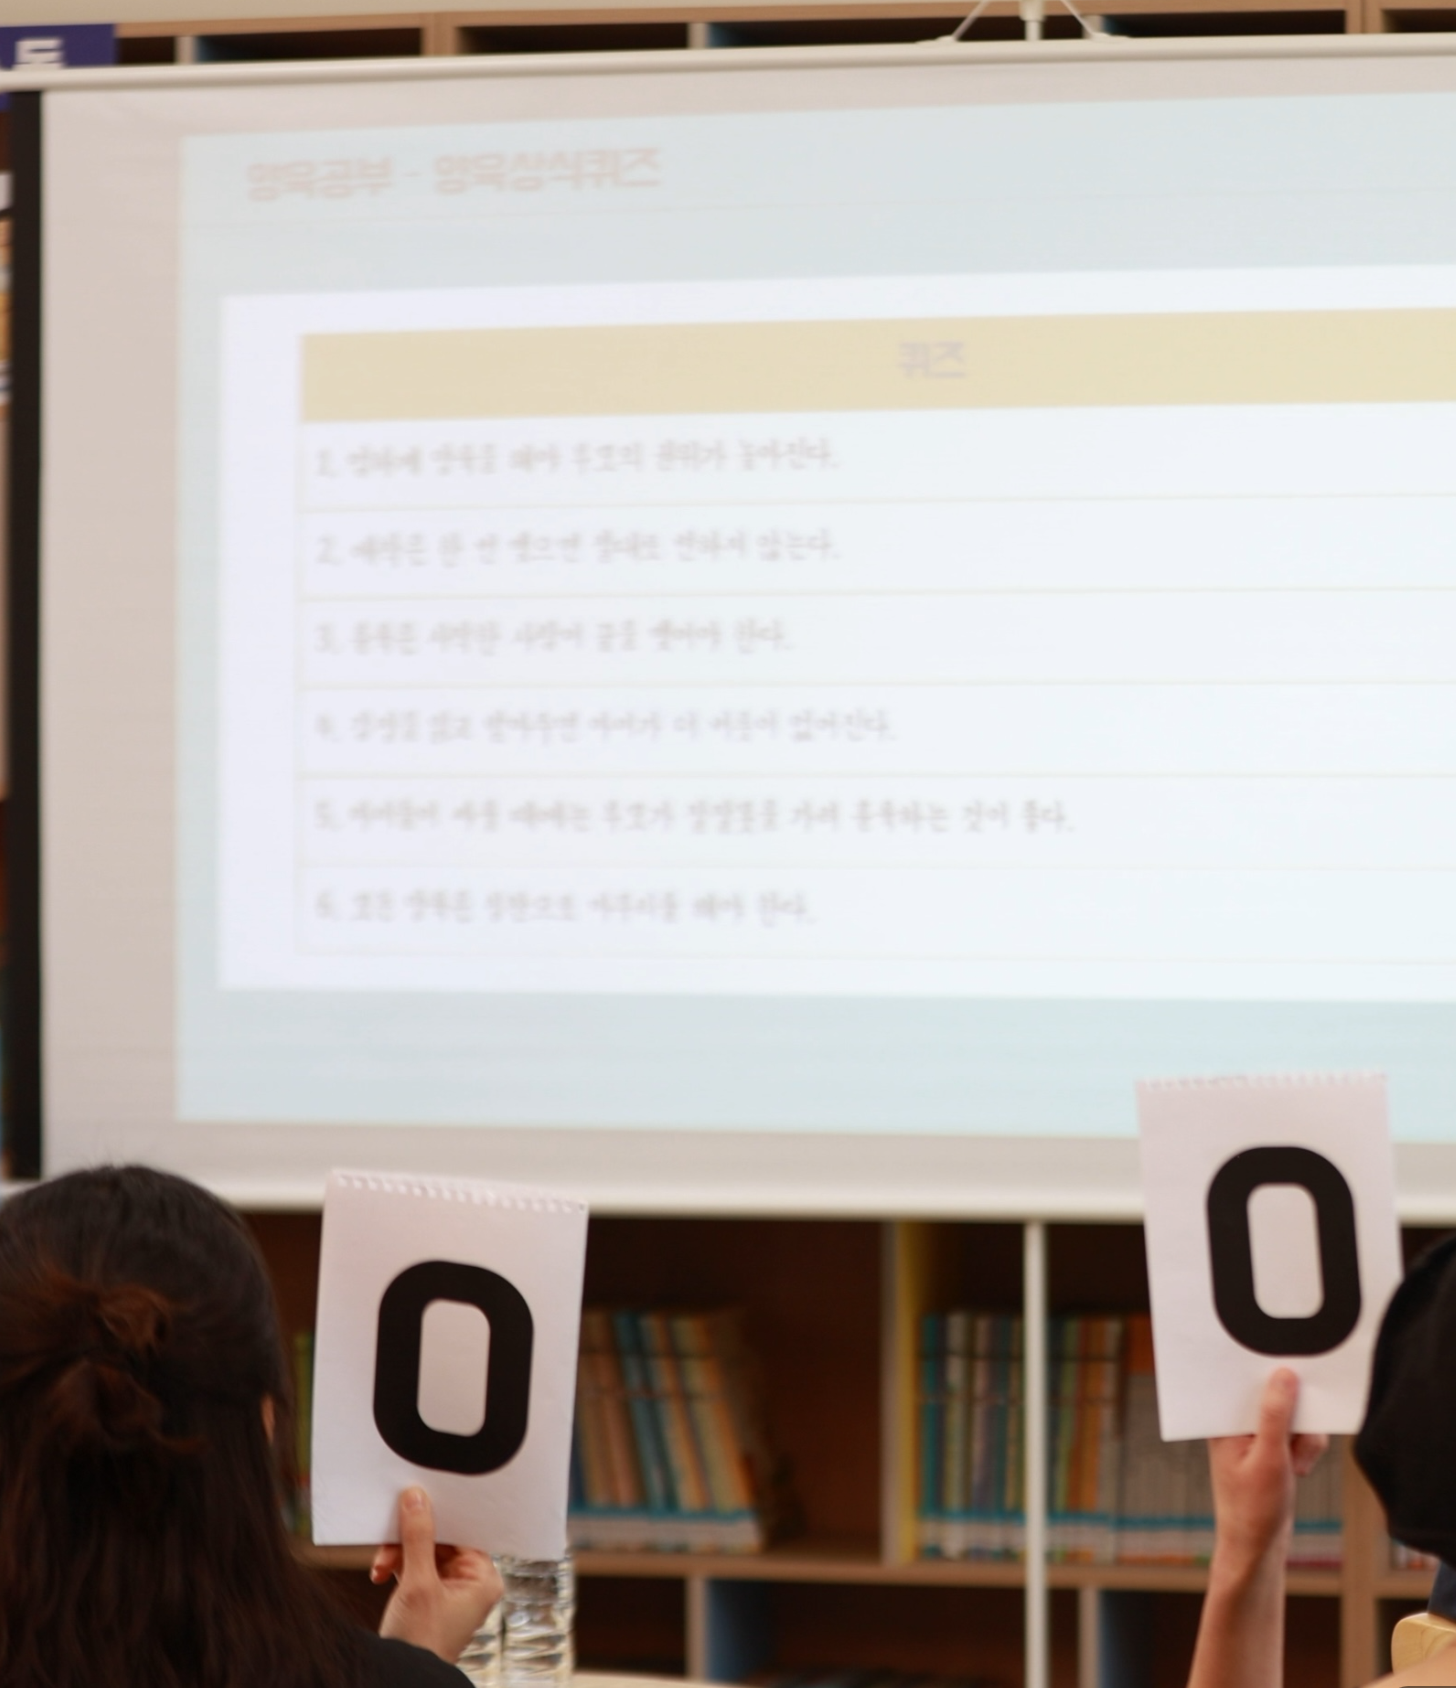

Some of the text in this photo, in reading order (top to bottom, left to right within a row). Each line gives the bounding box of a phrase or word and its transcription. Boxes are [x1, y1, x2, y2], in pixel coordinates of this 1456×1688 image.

[246, 155, 396, 201] 양육공부
[433, 147, 664, 196] 양육상식퀴즈
[897, 340, 967, 379] 퀴즈
[570, 441, 643, 476] 부모의
[654, 440, 726, 473] 권위가
[603, 798, 675, 831] 부모가
[962, 798, 1009, 833] 것이
